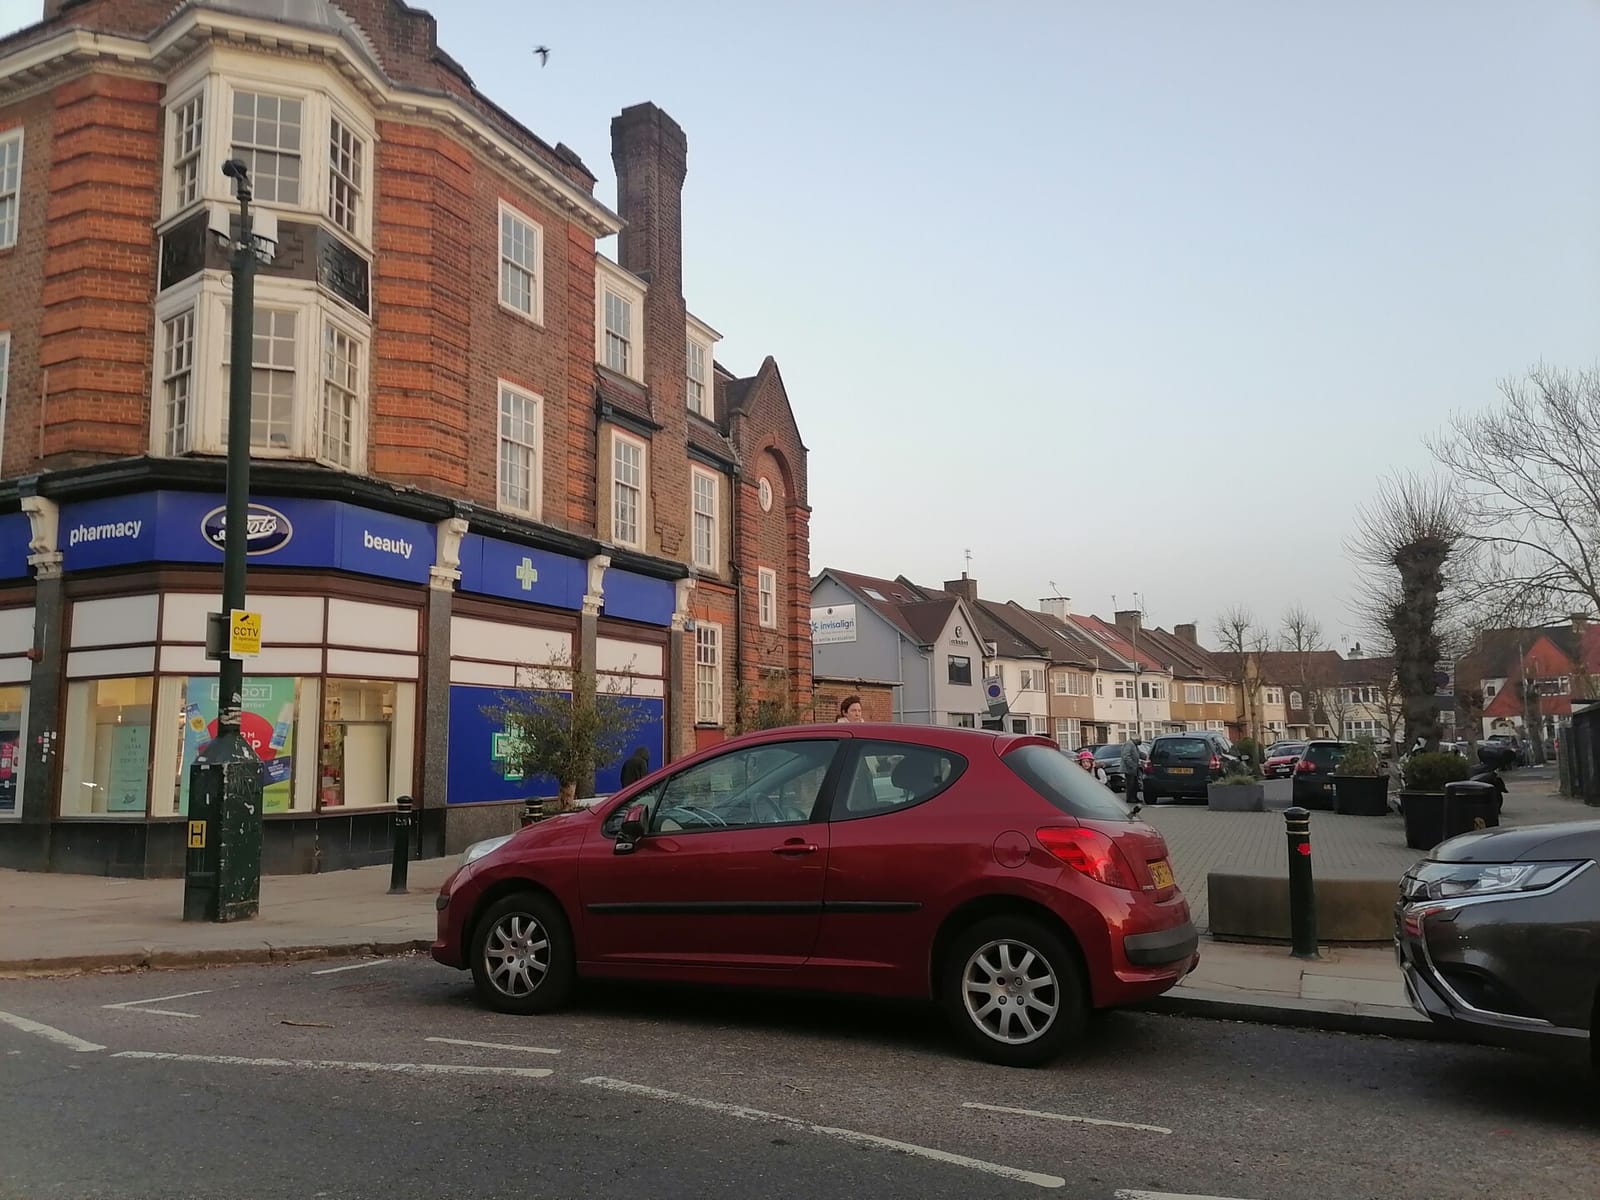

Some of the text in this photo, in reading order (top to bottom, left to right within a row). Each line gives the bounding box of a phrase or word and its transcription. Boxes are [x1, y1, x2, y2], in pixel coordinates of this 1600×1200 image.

[69, 520, 142, 547] pharmacy
[364, 529, 412, 559] beauty
[233, 626, 259, 637] CCTV
[820, 618, 854, 630] invisalign
[191, 823, 203, 846] H
